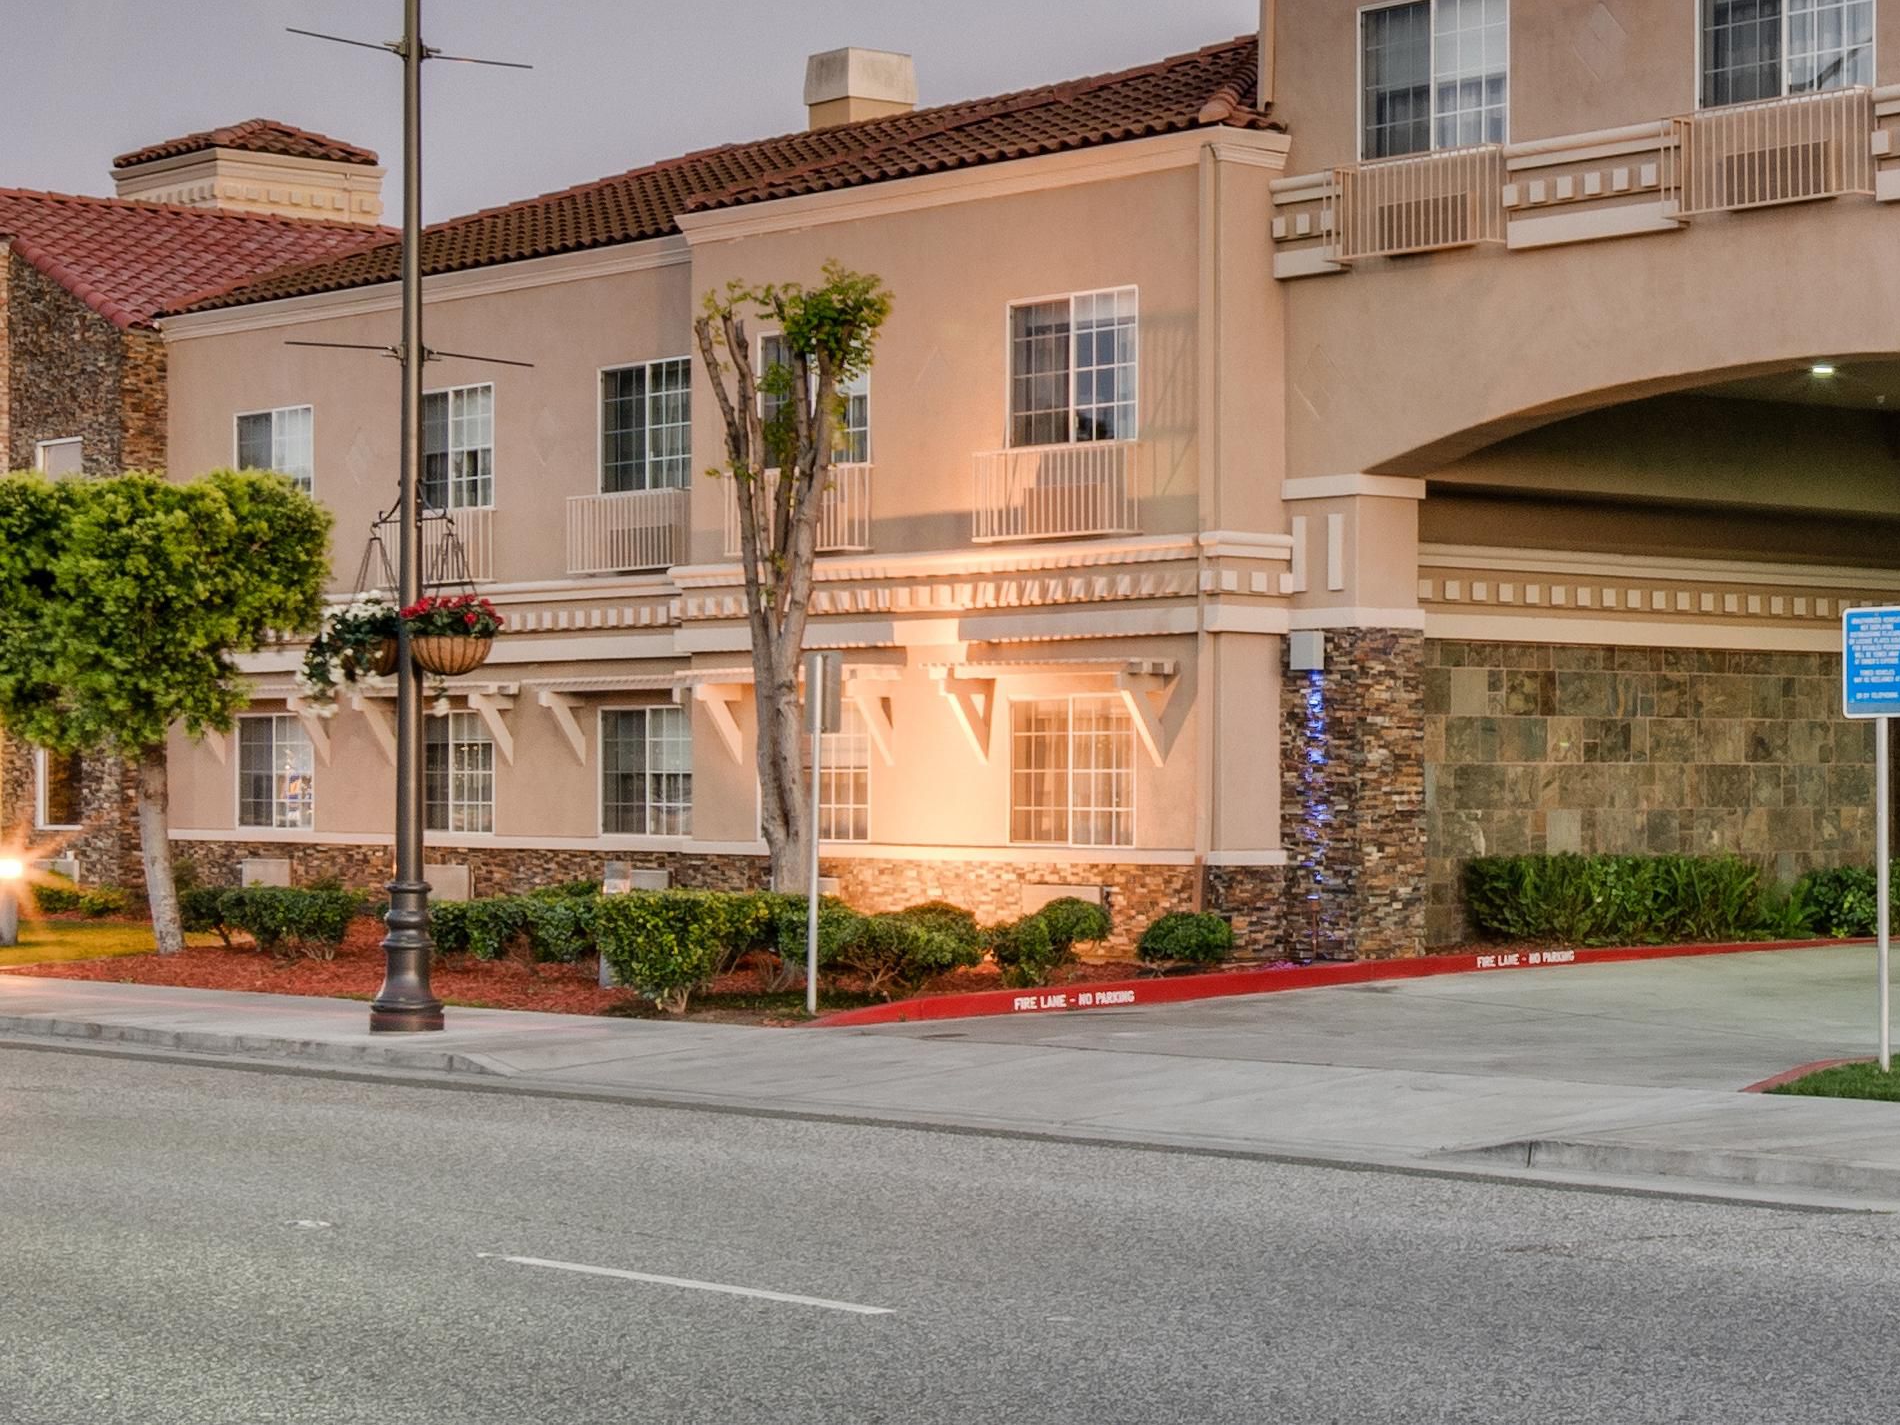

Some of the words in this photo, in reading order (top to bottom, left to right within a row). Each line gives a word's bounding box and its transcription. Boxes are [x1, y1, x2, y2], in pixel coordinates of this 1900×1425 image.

[1014, 996, 1038, 1011] FIRE
[1040, 994, 1067, 1008] LANE
[1078, 993, 1093, 1006] NO
[1095, 990, 1135, 1004] PARKING
